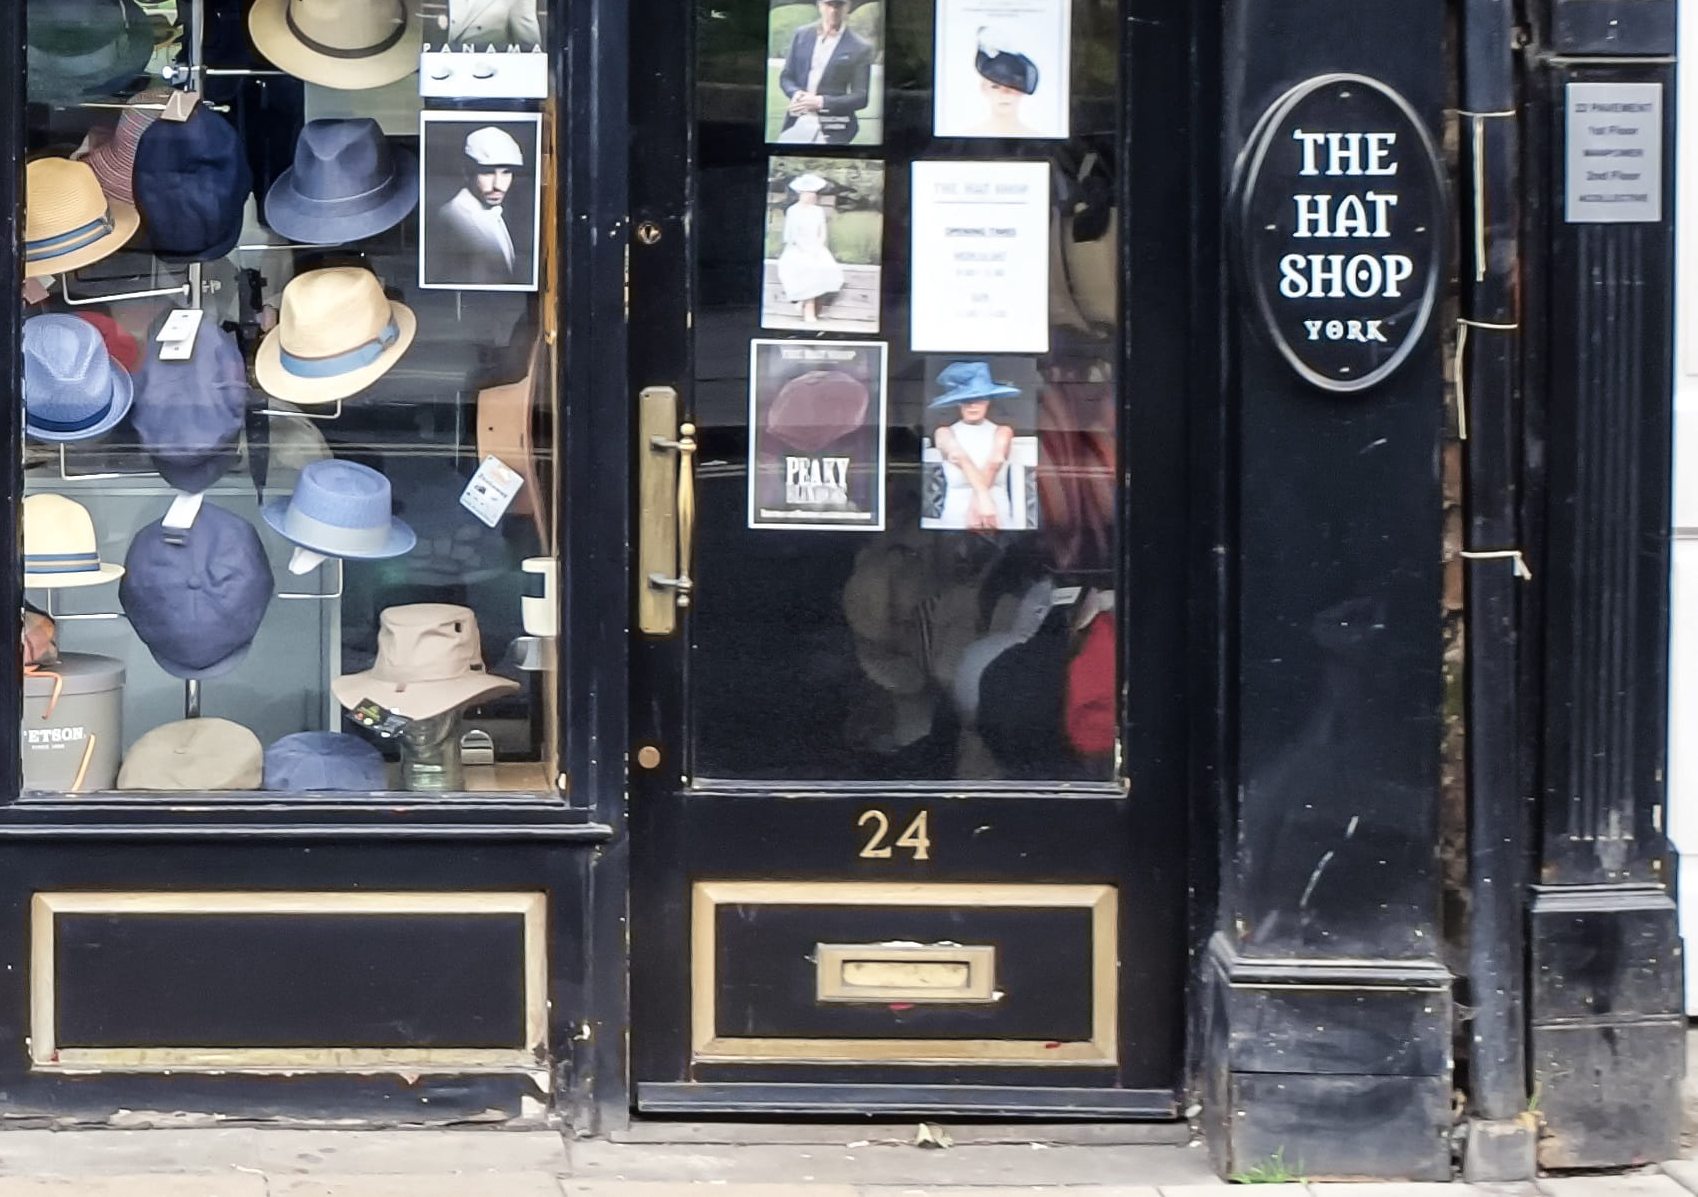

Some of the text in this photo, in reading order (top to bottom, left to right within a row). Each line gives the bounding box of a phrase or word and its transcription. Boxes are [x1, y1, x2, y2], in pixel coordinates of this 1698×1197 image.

[423, 42, 543, 53] PANAMA
[1292, 128, 1398, 176] THE
[1292, 190, 1398, 238] HAT
[1279, 253, 1413, 299] SHOP
[1303, 319, 1388, 343] YORK
[785, 456, 851, 488] PEAKY
[23, 726, 85, 743] ETSON
[858, 809, 931, 860] 24
